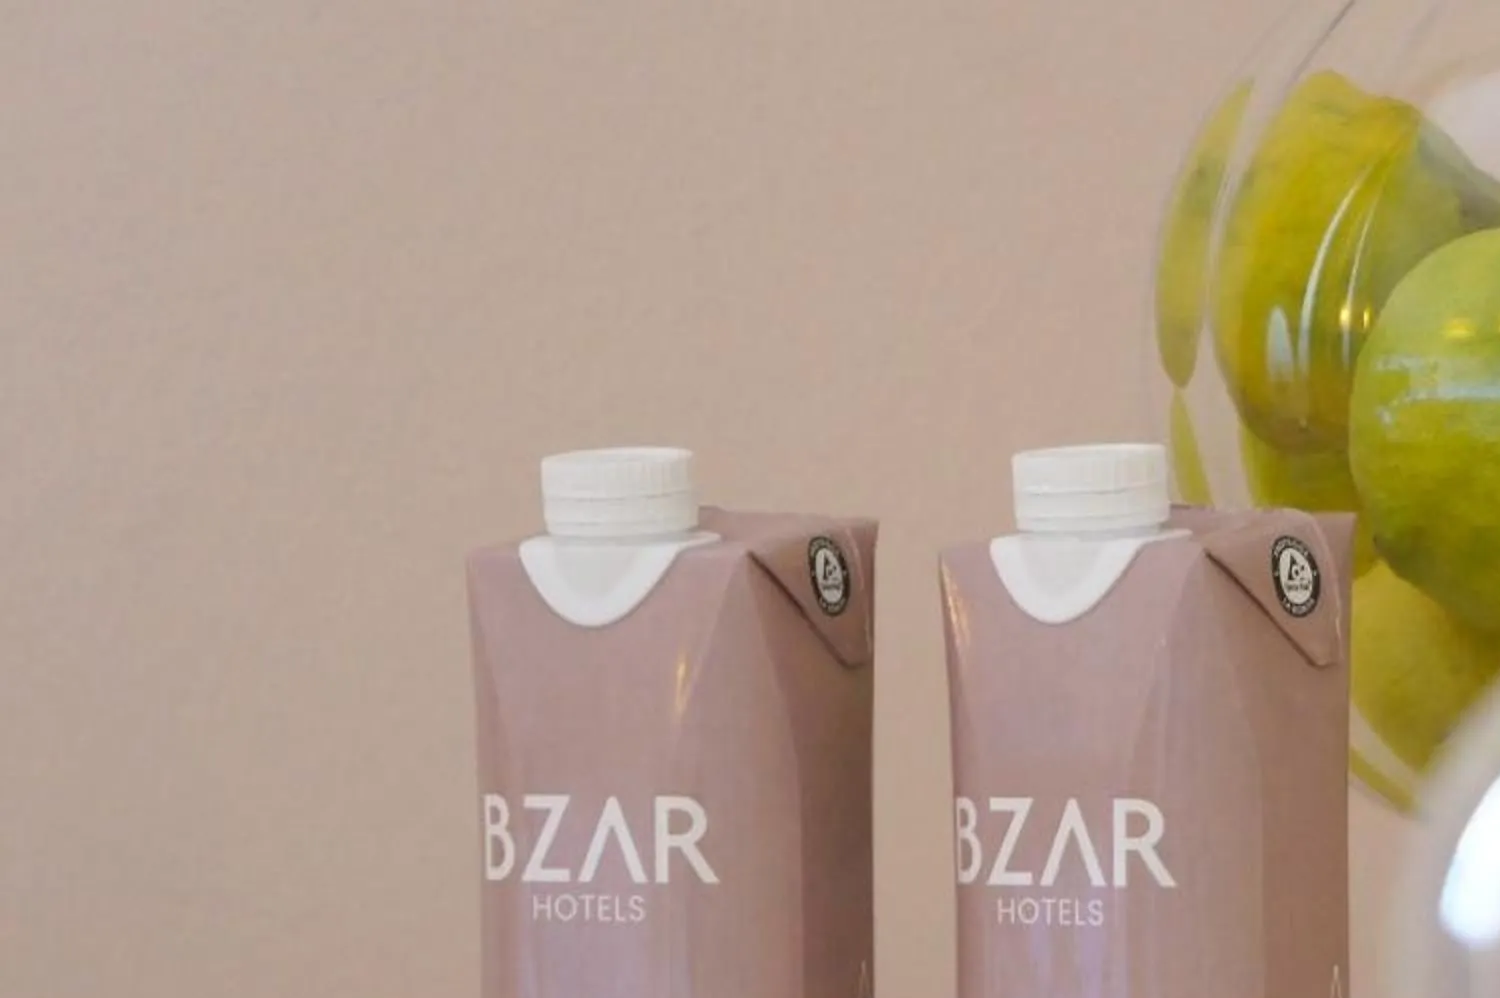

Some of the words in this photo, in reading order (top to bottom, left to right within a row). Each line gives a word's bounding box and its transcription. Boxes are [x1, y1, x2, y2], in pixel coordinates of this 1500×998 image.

[483, 793, 721, 884] BZAR
[956, 797, 1177, 888] BZAR
[533, 893, 646, 922] HOTELS
[998, 897, 1105, 926] HOTELS
